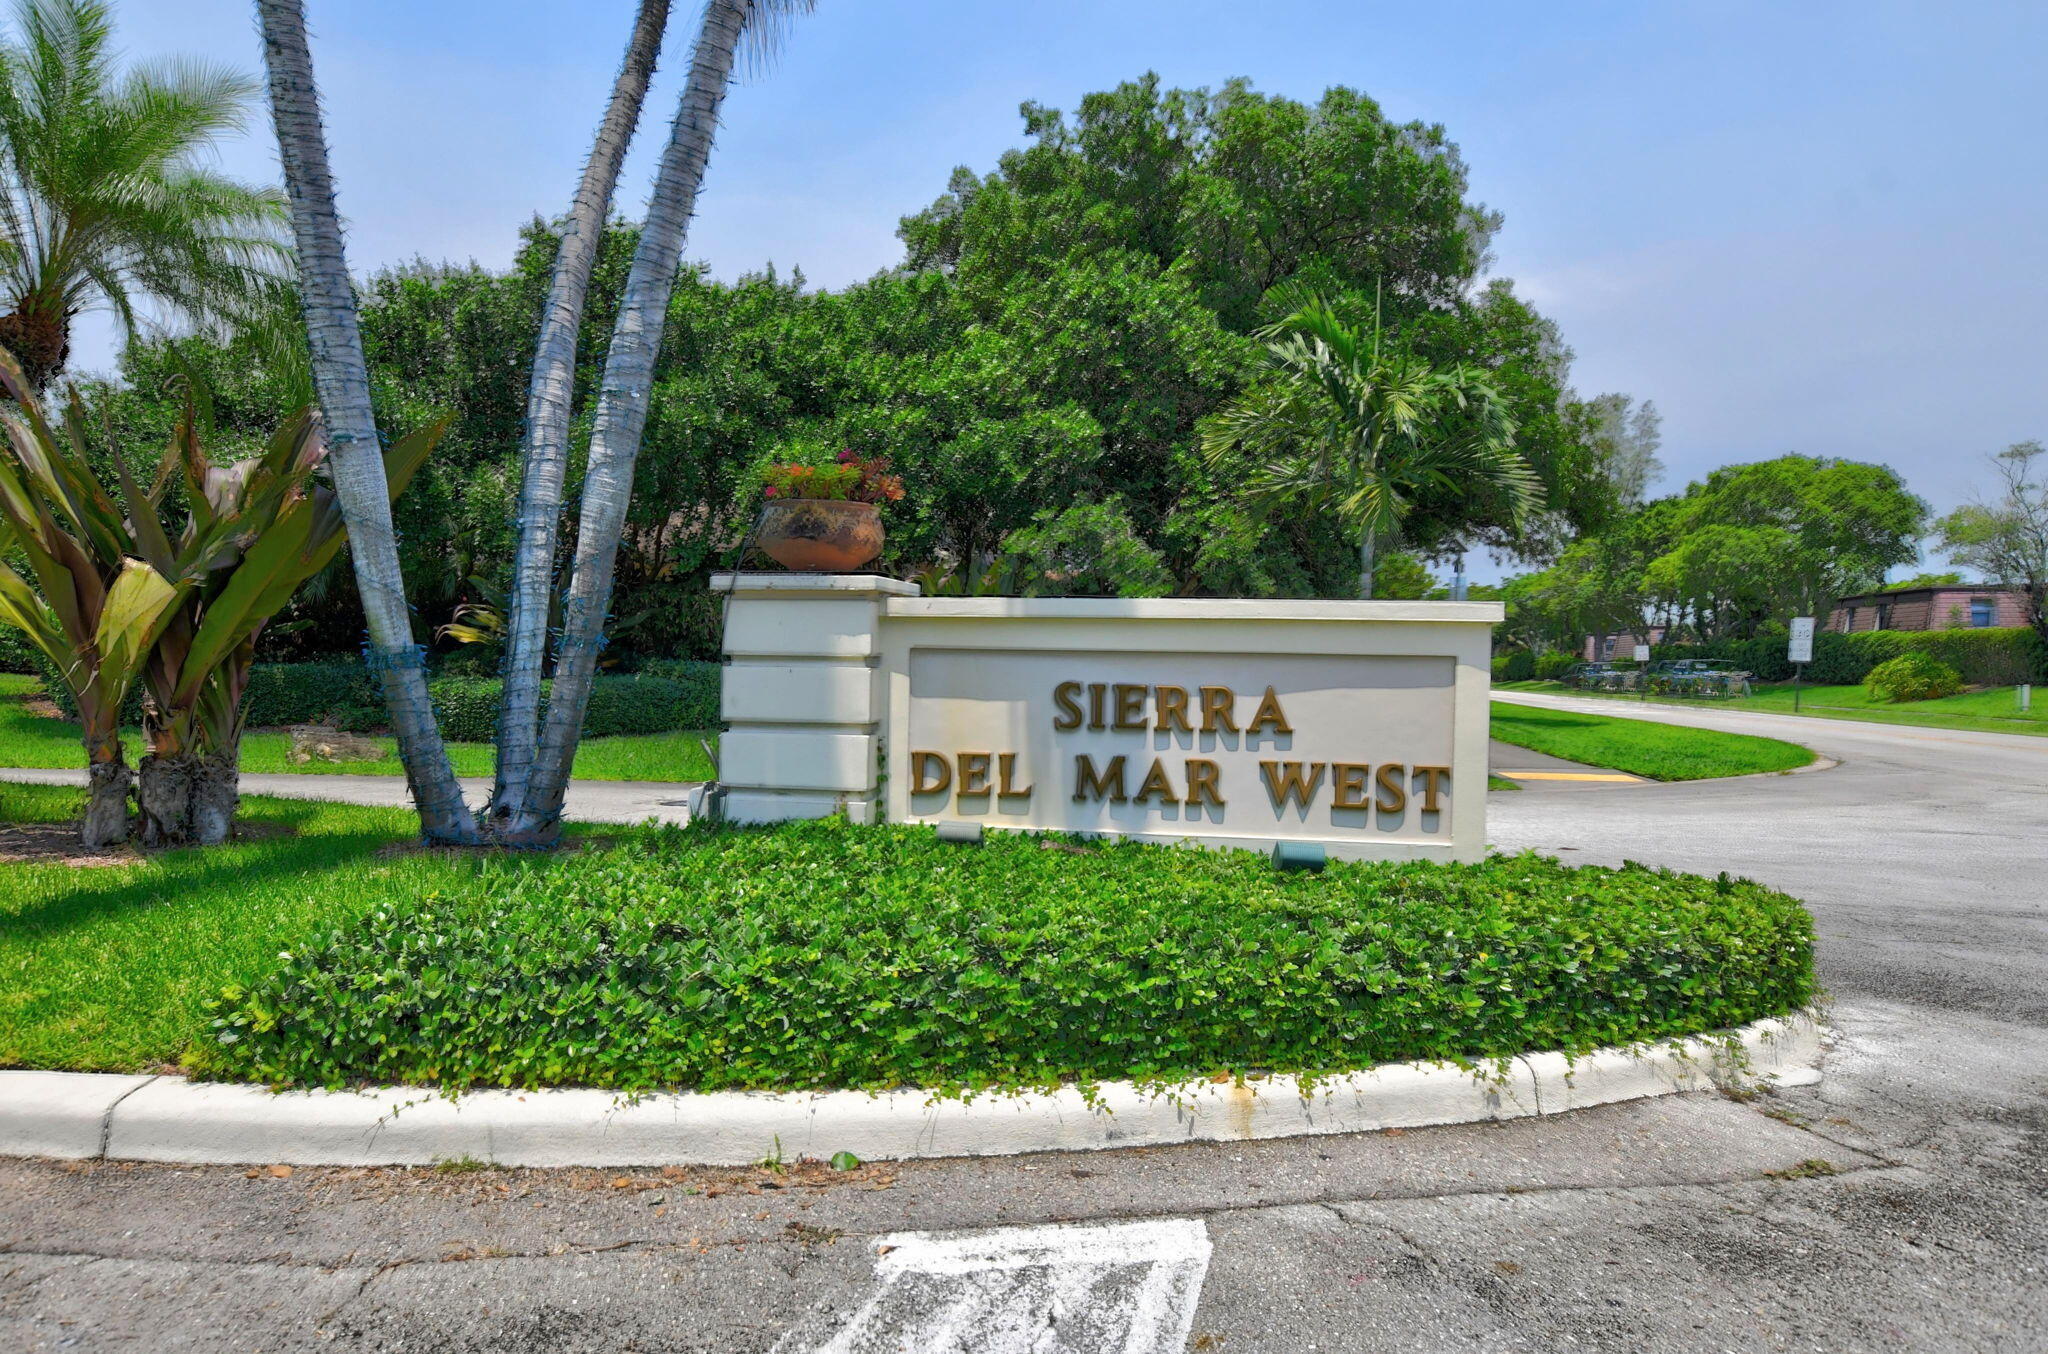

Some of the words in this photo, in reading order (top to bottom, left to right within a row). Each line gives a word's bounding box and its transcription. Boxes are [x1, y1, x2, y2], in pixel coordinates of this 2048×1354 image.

[1054, 680, 1293, 733] SIERRA
[911, 751, 1032, 798] DEL
[1073, 754, 1225, 804] MAR
[1259, 760, 1450, 813] WEST
